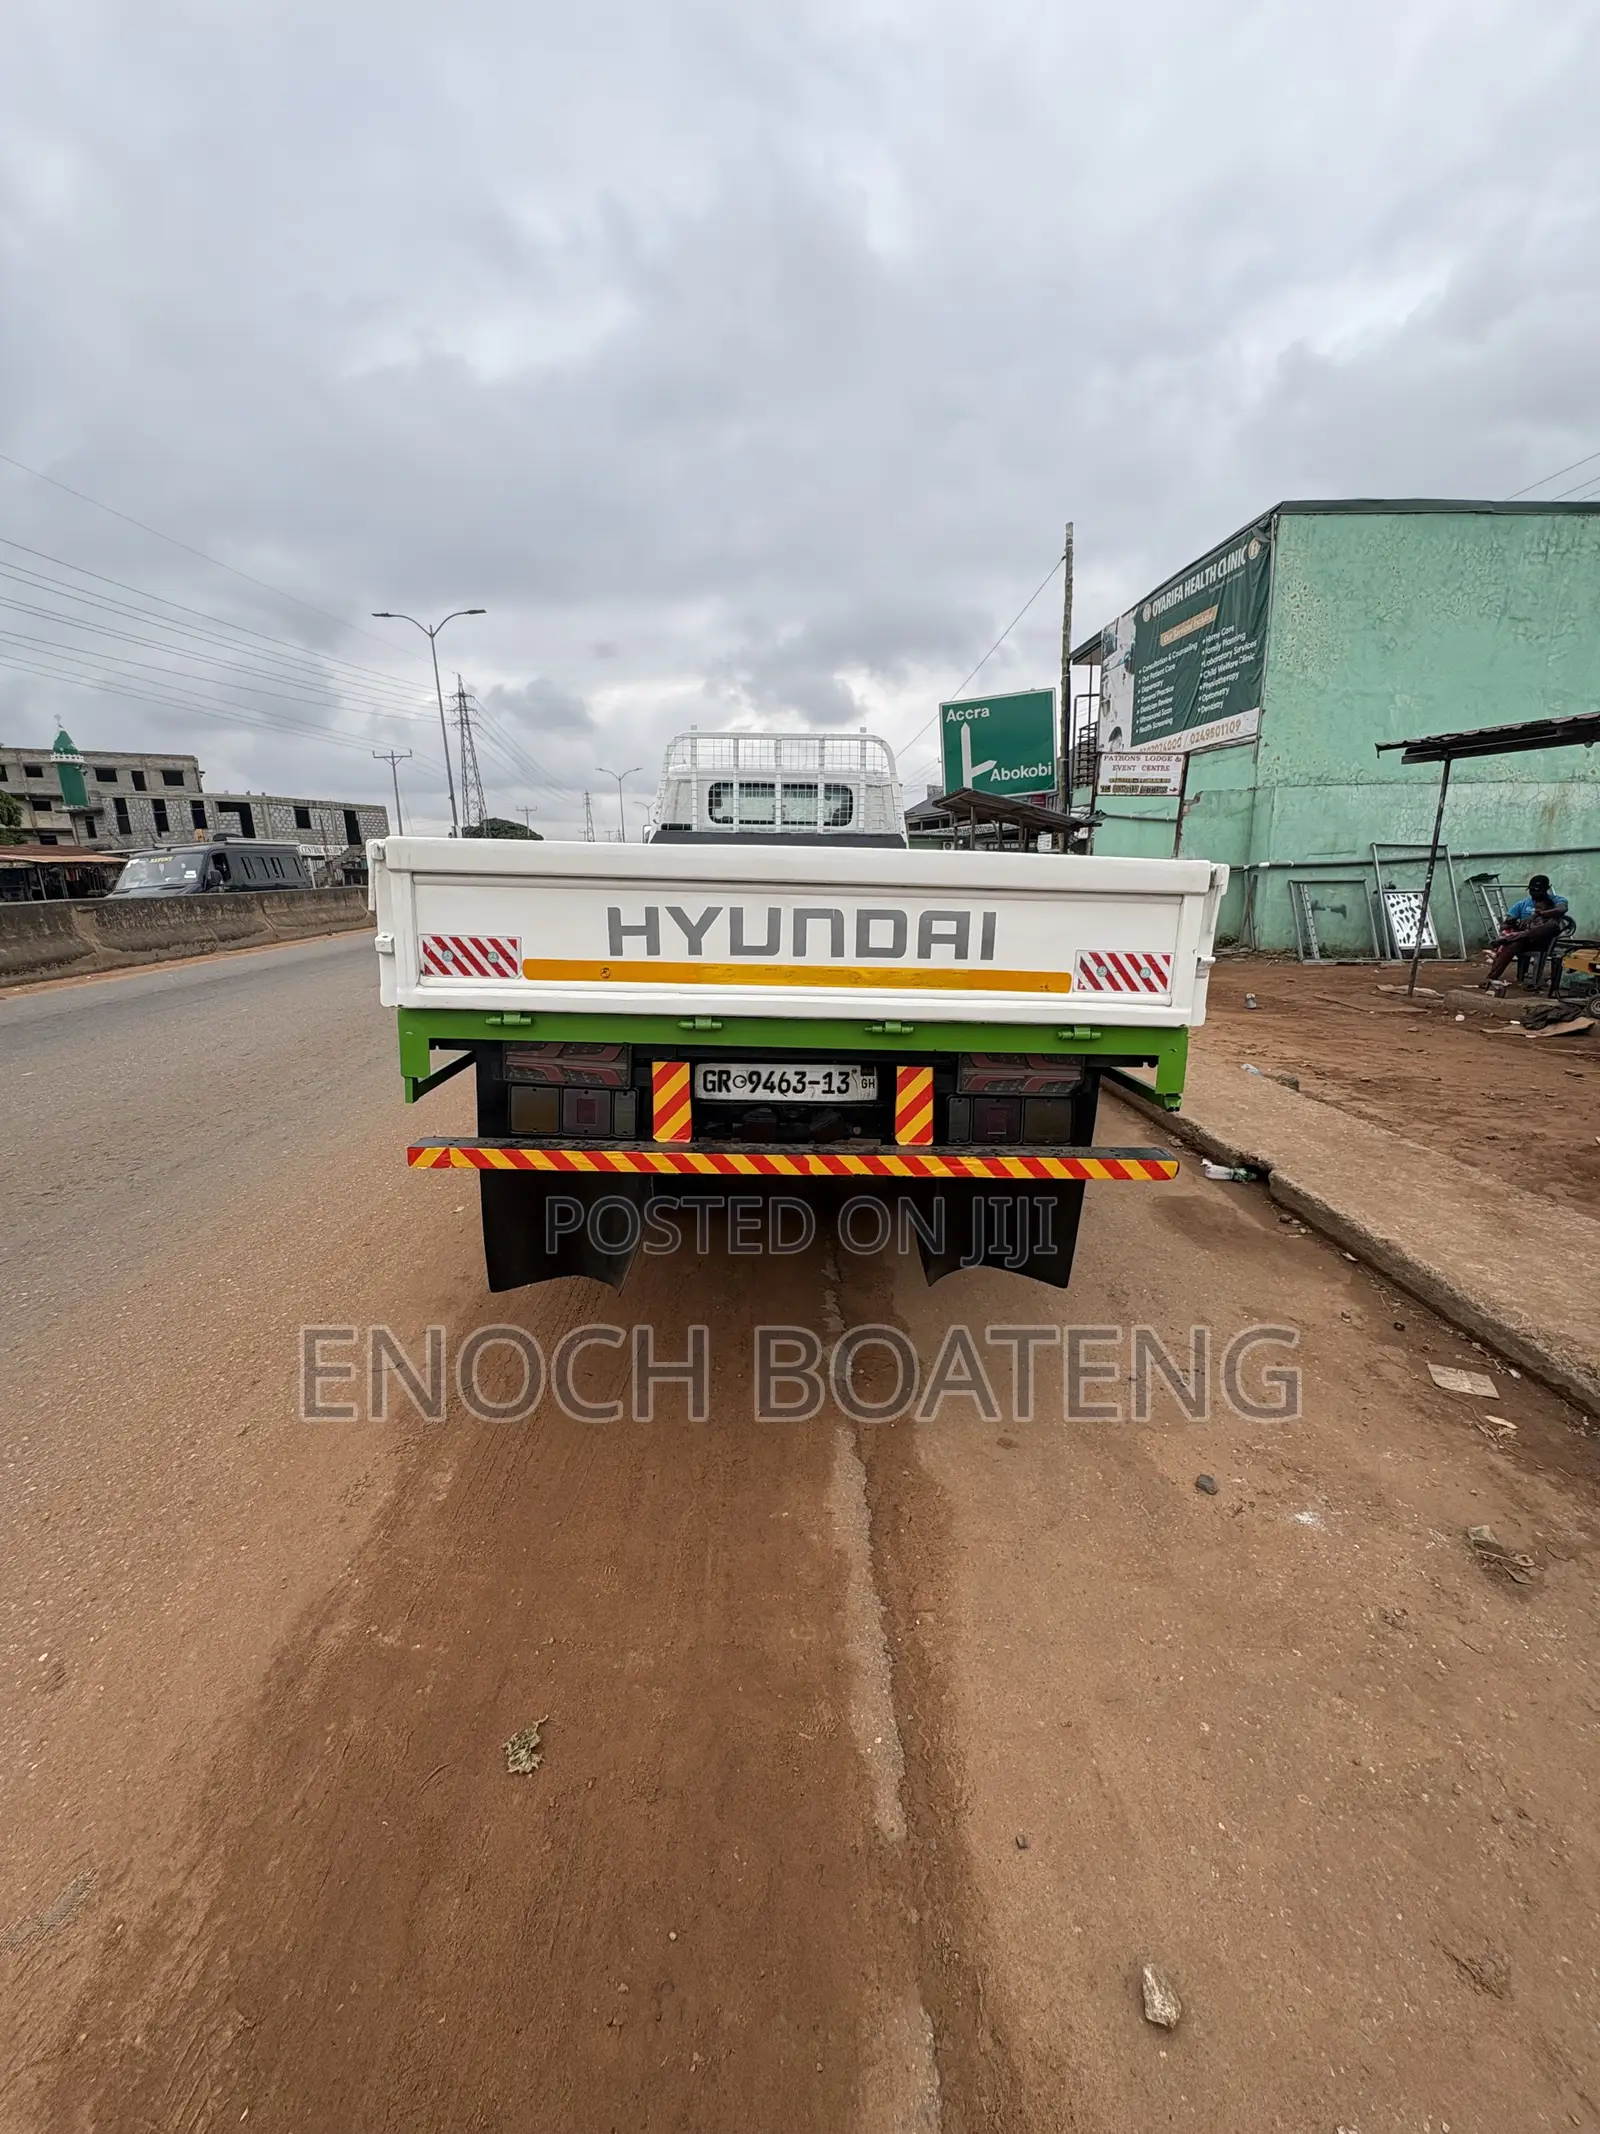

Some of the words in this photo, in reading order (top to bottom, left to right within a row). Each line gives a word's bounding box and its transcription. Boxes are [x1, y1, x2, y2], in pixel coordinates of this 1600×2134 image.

[1152, 584, 1184, 617] OYARIFA
[1184, 563, 1217, 599] HEALTH
[1217, 544, 1248, 579] CLINIC
[1221, 625, 1235, 636] Care
[1222, 632, 1246, 647] Planning
[1203, 650, 1233, 668] Laboratory
[1233, 640, 1258, 655] Services
[1203, 667, 1217, 679] Child
[1218, 660, 1239, 673] Welfare
[1239, 651, 1255, 664] Clinic
[1202, 671, 1240, 691] Physiotherapy
[1202, 687, 1230, 702] Optometry
[946, 707, 990, 723] Accra
[1201, 700, 1224, 714] Dentistry
[990, 762, 1052, 782] Abokobi
[607, 906, 996, 961] HYUNDAI
[861, 1077, 875, 1089] GH
